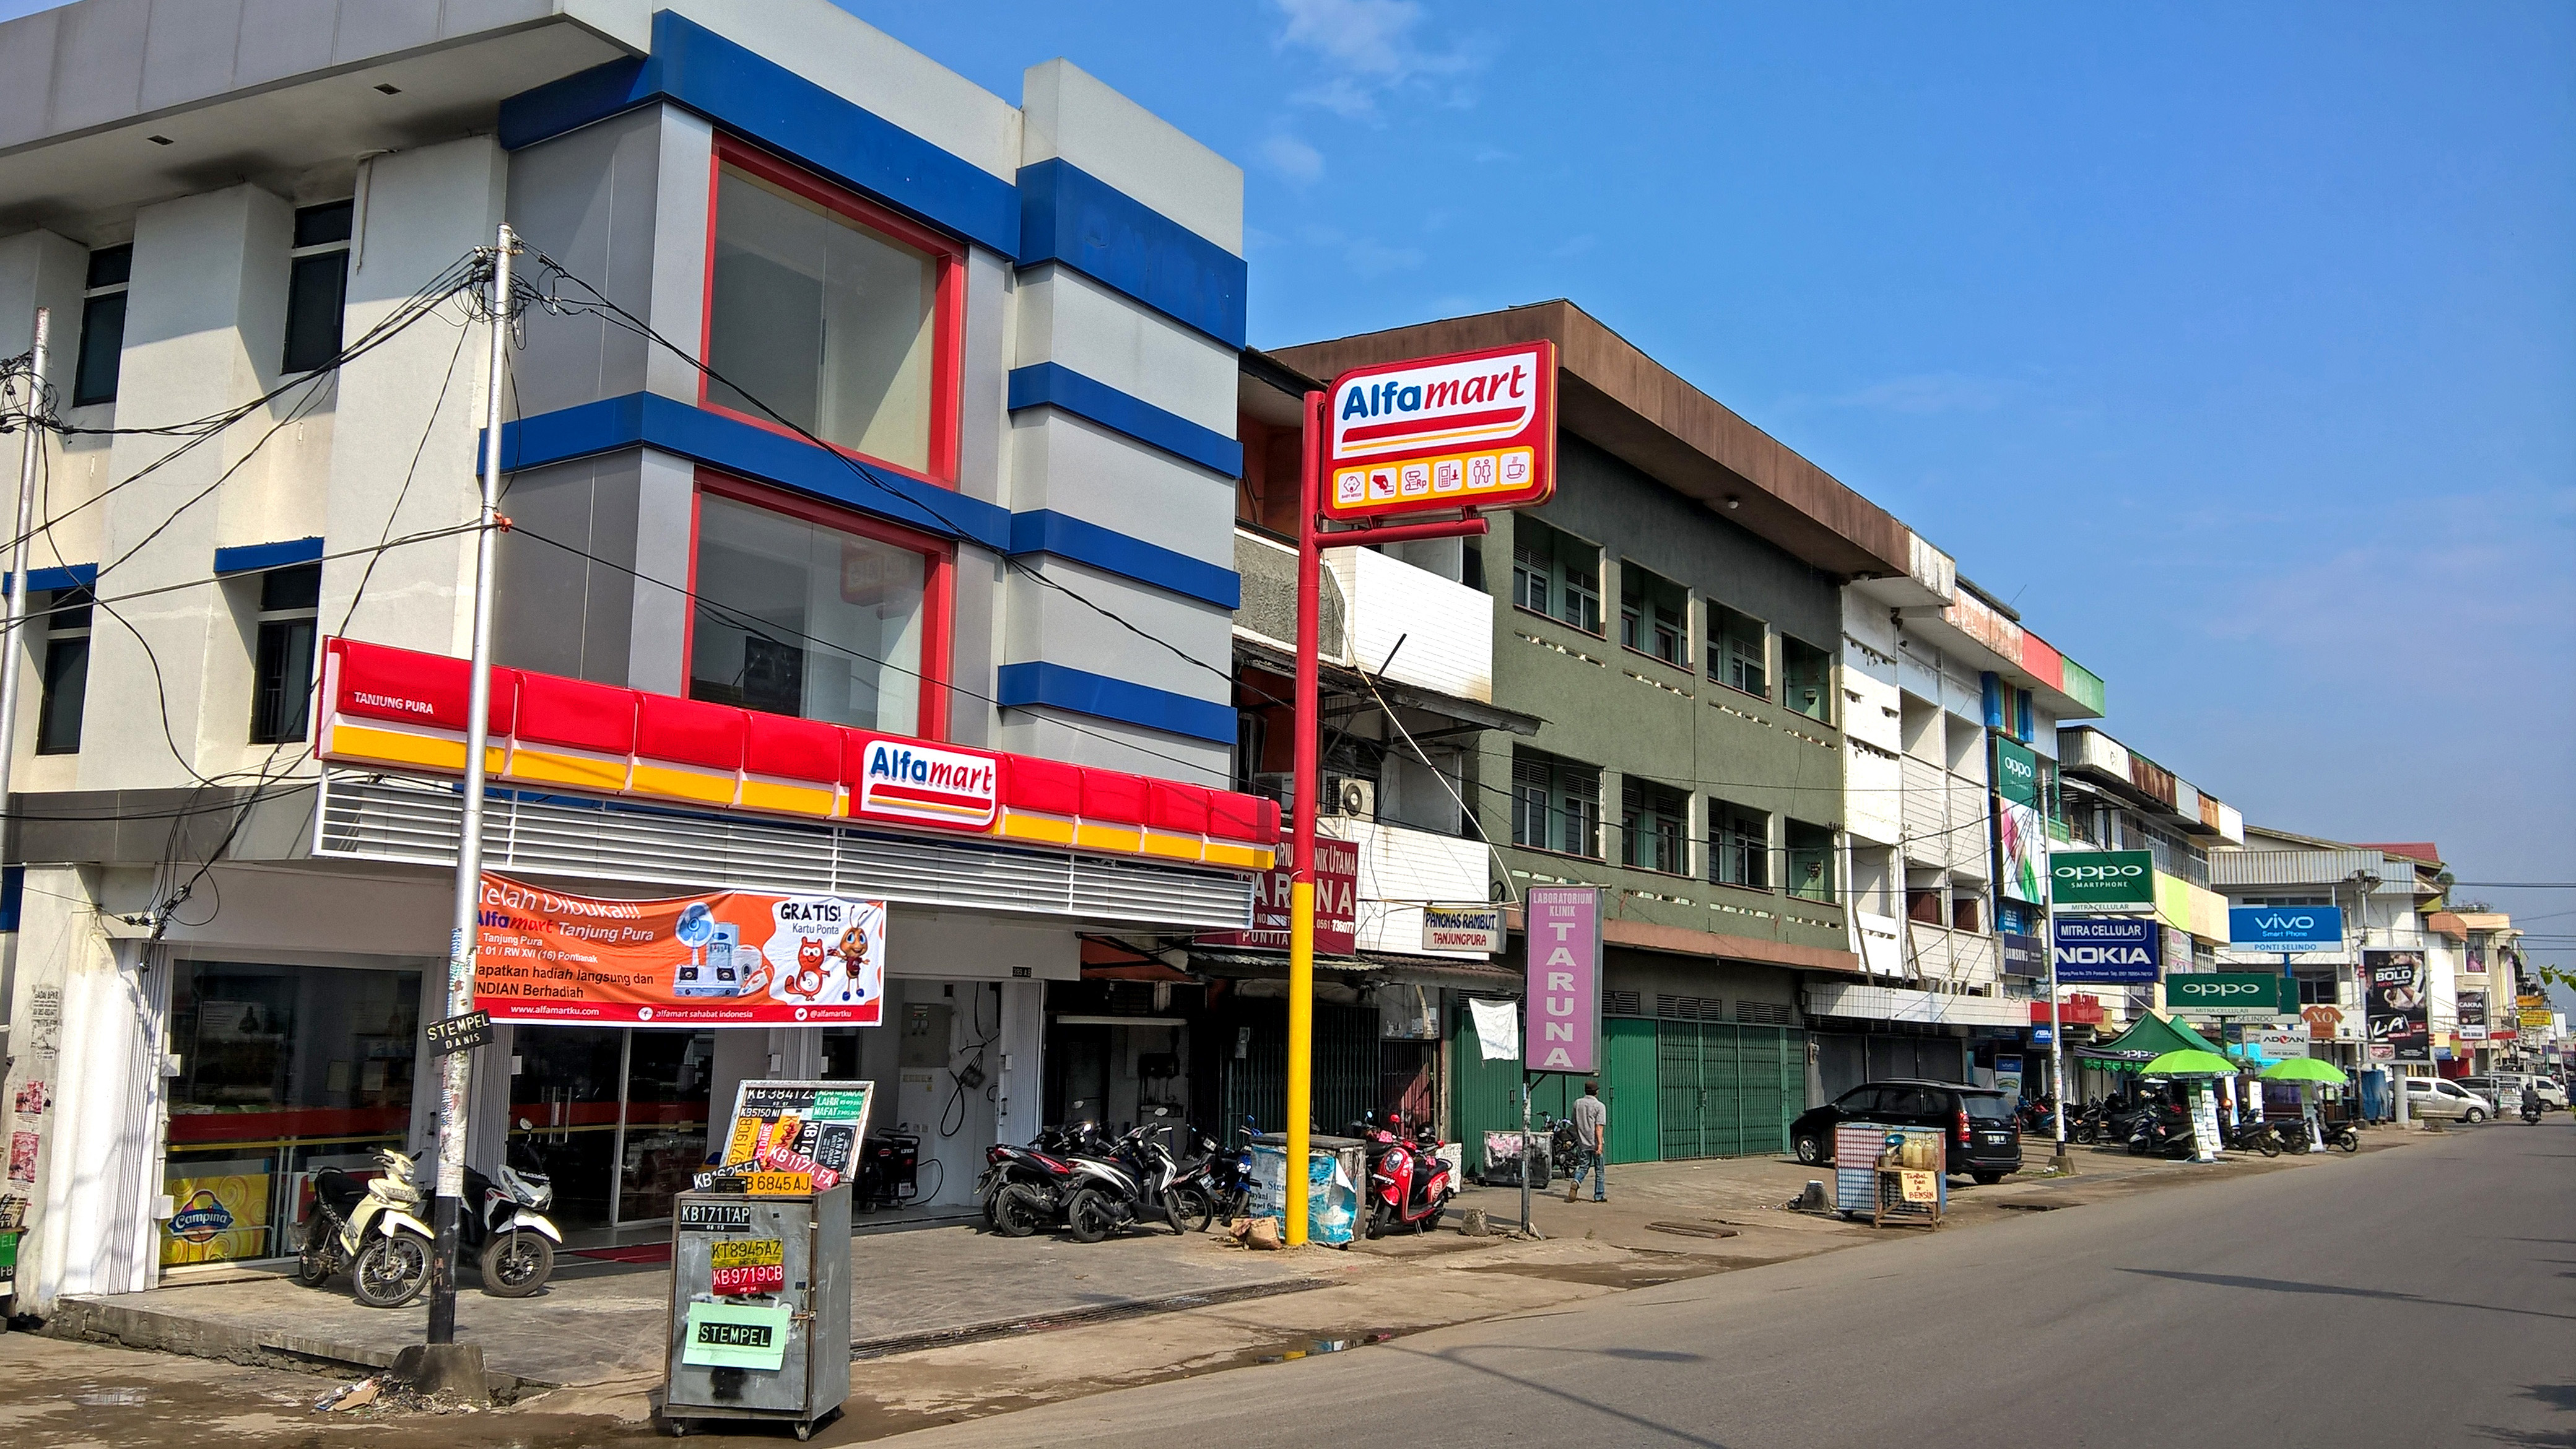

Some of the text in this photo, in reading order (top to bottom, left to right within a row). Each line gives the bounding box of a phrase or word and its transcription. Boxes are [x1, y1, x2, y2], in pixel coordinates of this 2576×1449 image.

[1342, 364, 1527, 421] Alfamart
[1417, 479, 1427, 489] Rp
[354, 691, 434, 715] TANJUNG PURA
[870, 746, 993, 792] Alfamart
[1329, 845, 1356, 876] UTAMA
[478, 880, 536, 910] Telah
[1533, 892, 1593, 905] LABORATORIUM
[543, 893, 642, 920] Dibuka!!!
[780, 902, 842, 923] GRATIS!
[1549, 905, 1576, 918] KLINIK
[793, 923, 839, 935] Kartu Ponta
[1425, 912, 1496, 929] PANGKAS RAMBUT
[559, 921, 619, 943] Tanjung
[621, 926, 654, 941] Pura
[1242, 931, 1289, 946] PONTIA
[1433, 932, 1487, 946] TANJUNGPURA
[2061, 925, 2142, 936] MITRA CELLULAR
[484, 933, 518, 946] Tanjung
[520, 936, 543, 947] Pura
[485, 946, 496, 955] 01
[504, 947, 520, 957] RW
[521, 948, 536, 959] XVI
[537, 949, 556, 961] (16)
[558, 951, 598, 964] Pontianak
[2055, 947, 2152, 964] NOKIA
[475, 964, 529, 981] apatkan
[533, 965, 573, 981] hadiah
[577, 970, 630, 986] langsung
[633, 973, 653, 985] dan
[2375, 970, 2412, 981] BOLD
[523, 983, 583, 998] Berhadiah
[1543, 921, 1577, 1068] TARUNA
[510, 1006, 852, 1019] www.alfamartku.com alfamart sahabat indonesia @alfamartku
[427, 1013, 490, 1042] STEMPEL
[445, 1032, 481, 1050] DANIS
[769, 1144, 790, 1162] KB
[757, 1175, 791, 1191] 6845
[793, 1176, 811, 1191] AJ
[175, 1211, 228, 1229] Campina
[713, 1265, 783, 1286] KB9719CB
[700, 1325, 768, 1346] STEMPEL
